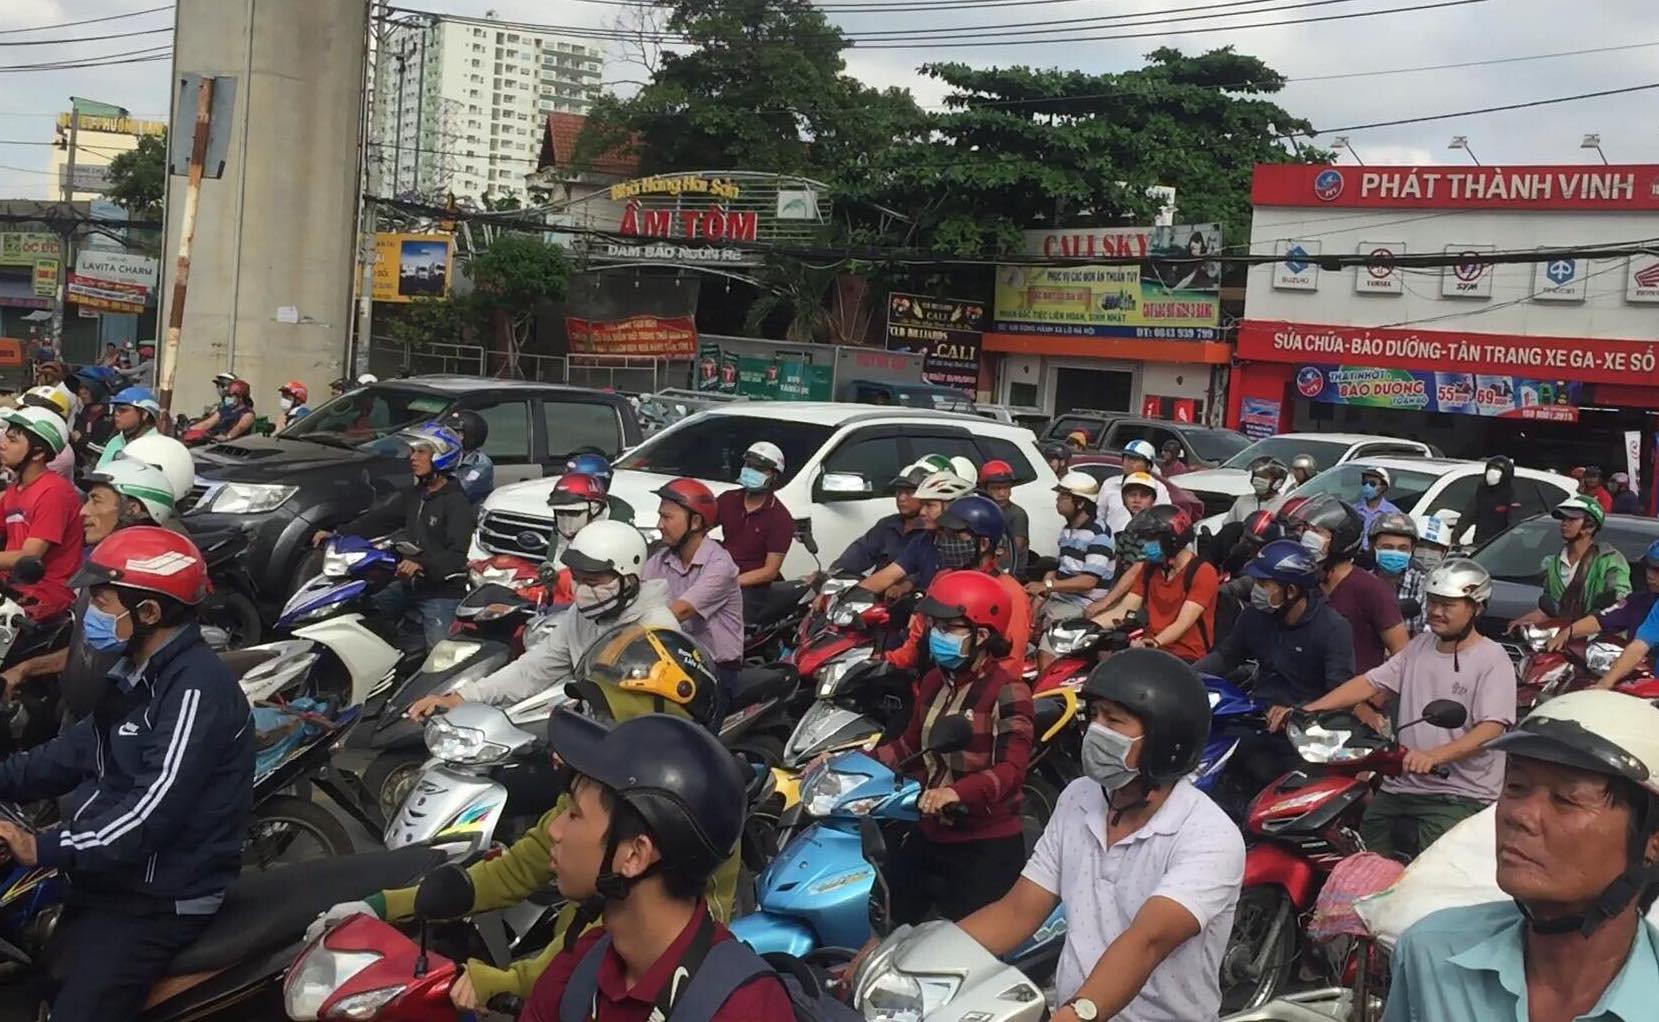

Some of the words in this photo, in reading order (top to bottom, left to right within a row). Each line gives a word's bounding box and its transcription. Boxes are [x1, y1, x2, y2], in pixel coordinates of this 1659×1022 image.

[1361, 168, 1440, 198] PHÁT
[1447, 168, 1553, 199] THÀNH
[1559, 173, 1635, 200] VINH
[1103, 233, 1149, 258] SKY
[82, 262, 116, 274] LAVITA
[118, 264, 153, 276] CHARM
[1456, 282, 1478, 291] SYM
[937, 343, 976, 360] CALI
[1274, 326, 1301, 350] SỬA
[1484, 345, 1541, 365] TRANG
[1544, 349, 1567, 367] XE
[1630, 345, 1655, 372] SỐ
[1437, 386, 1454, 401] 55
[1477, 389, 1494, 404] 69
